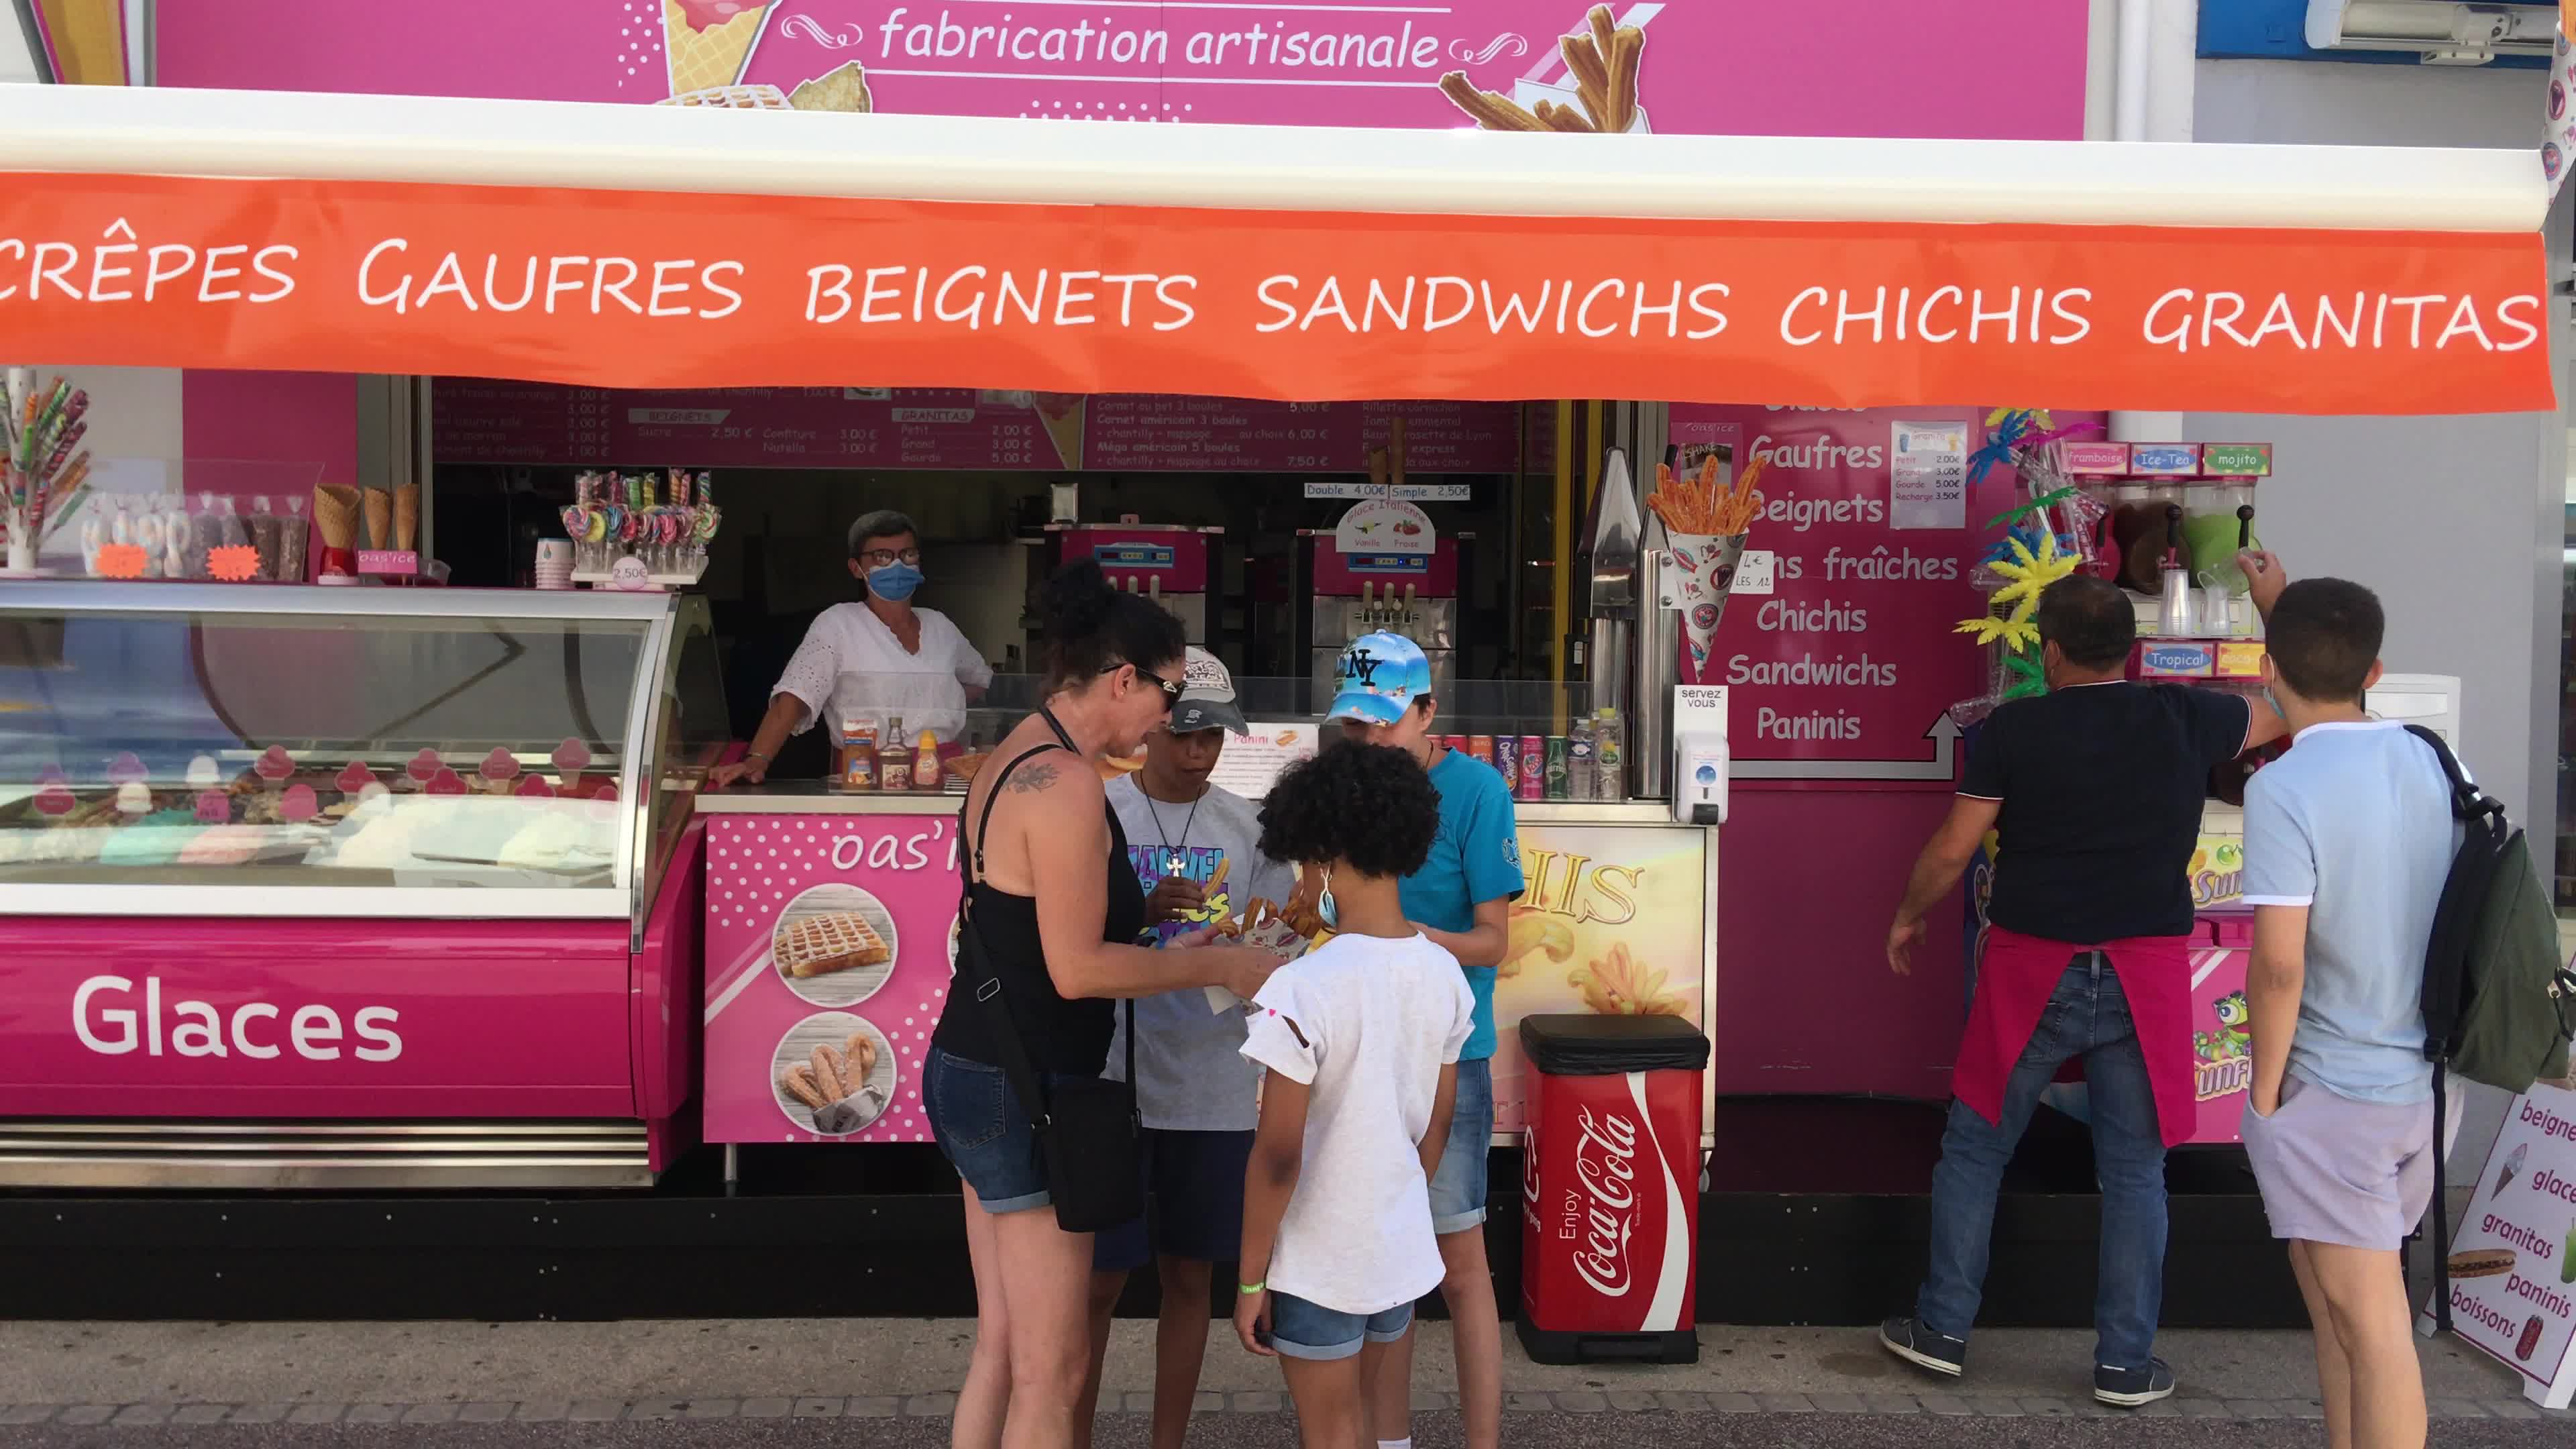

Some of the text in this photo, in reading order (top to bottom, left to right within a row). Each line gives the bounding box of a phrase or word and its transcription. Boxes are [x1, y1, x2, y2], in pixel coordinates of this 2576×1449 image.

[880, 7, 1439, 68] fabrication artisanale
[358, 237, 744, 319] GAUFRES
[805, 264, 1197, 331] BEIGNETS
[1255, 274, 1729, 339] SANDWICHS
[1780, 285, 2092, 345] CHICHIS
[2143, 288, 2539, 353] GRANITAS
[1749, 434, 1883, 470] Gaufres
[2070, 450, 2123, 464] framboise
[2141, 452, 2190, 466] Ice-Tea
[2218, 453, 2257, 468] mojito
[1307, 486, 1344, 496] Double
[1391, 488, 1428, 500] Simple
[1895, 492, 1933, 503] Recharge
[1823, 545, 1958, 582] fraîches
[1756, 599, 1867, 633] Chichis
[1346, 649, 1384, 686] NY
[1725, 652, 1897, 688] Sandwichs
[2151, 653, 2204, 669] Tropical
[1681, 689, 1722, 699] servez
[1687, 699, 1716, 708] vous
[1234, 735, 1269, 745] Panini
[1757, 706, 1862, 740] Paninis
[72, 975, 402, 1061] Glaces
[1559, 1189, 1582, 1240] Enjoy
[1572, 1104, 1636, 1297] Coca-Cola
[2481, 1212, 2554, 1260] granitas
[2450, 1283, 2517, 1338] boissons
[2504, 1273, 2572, 1319] paninis
